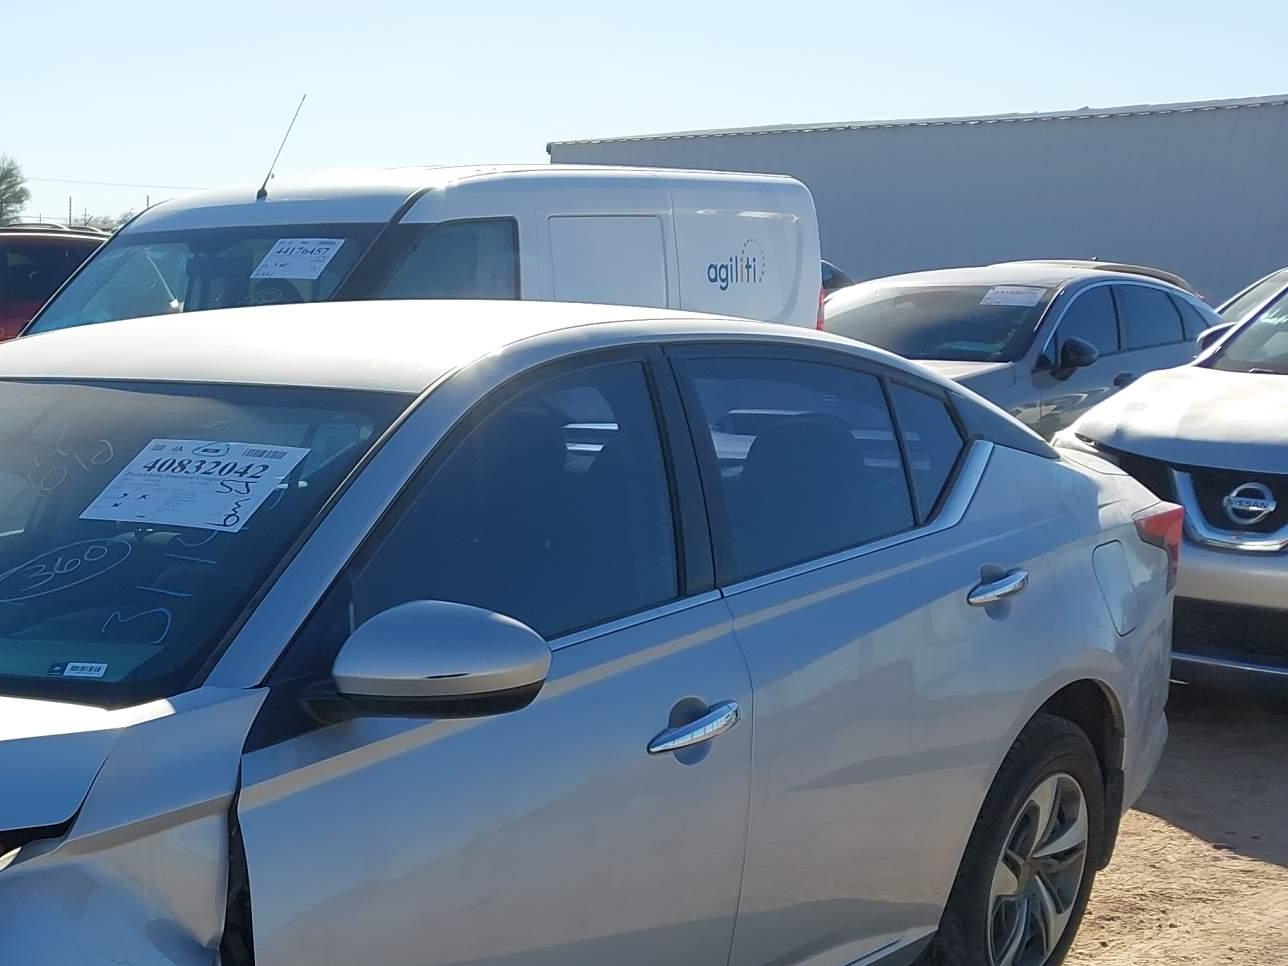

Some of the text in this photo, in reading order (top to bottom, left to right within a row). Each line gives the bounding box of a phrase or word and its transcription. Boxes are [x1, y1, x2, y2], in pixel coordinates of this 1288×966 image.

[707, 255, 757, 291] agiliti
[142, 456, 271, 479] 40832042
[1227, 497, 1269, 509] NISSAN
[19, 544, 109, 592] 360
